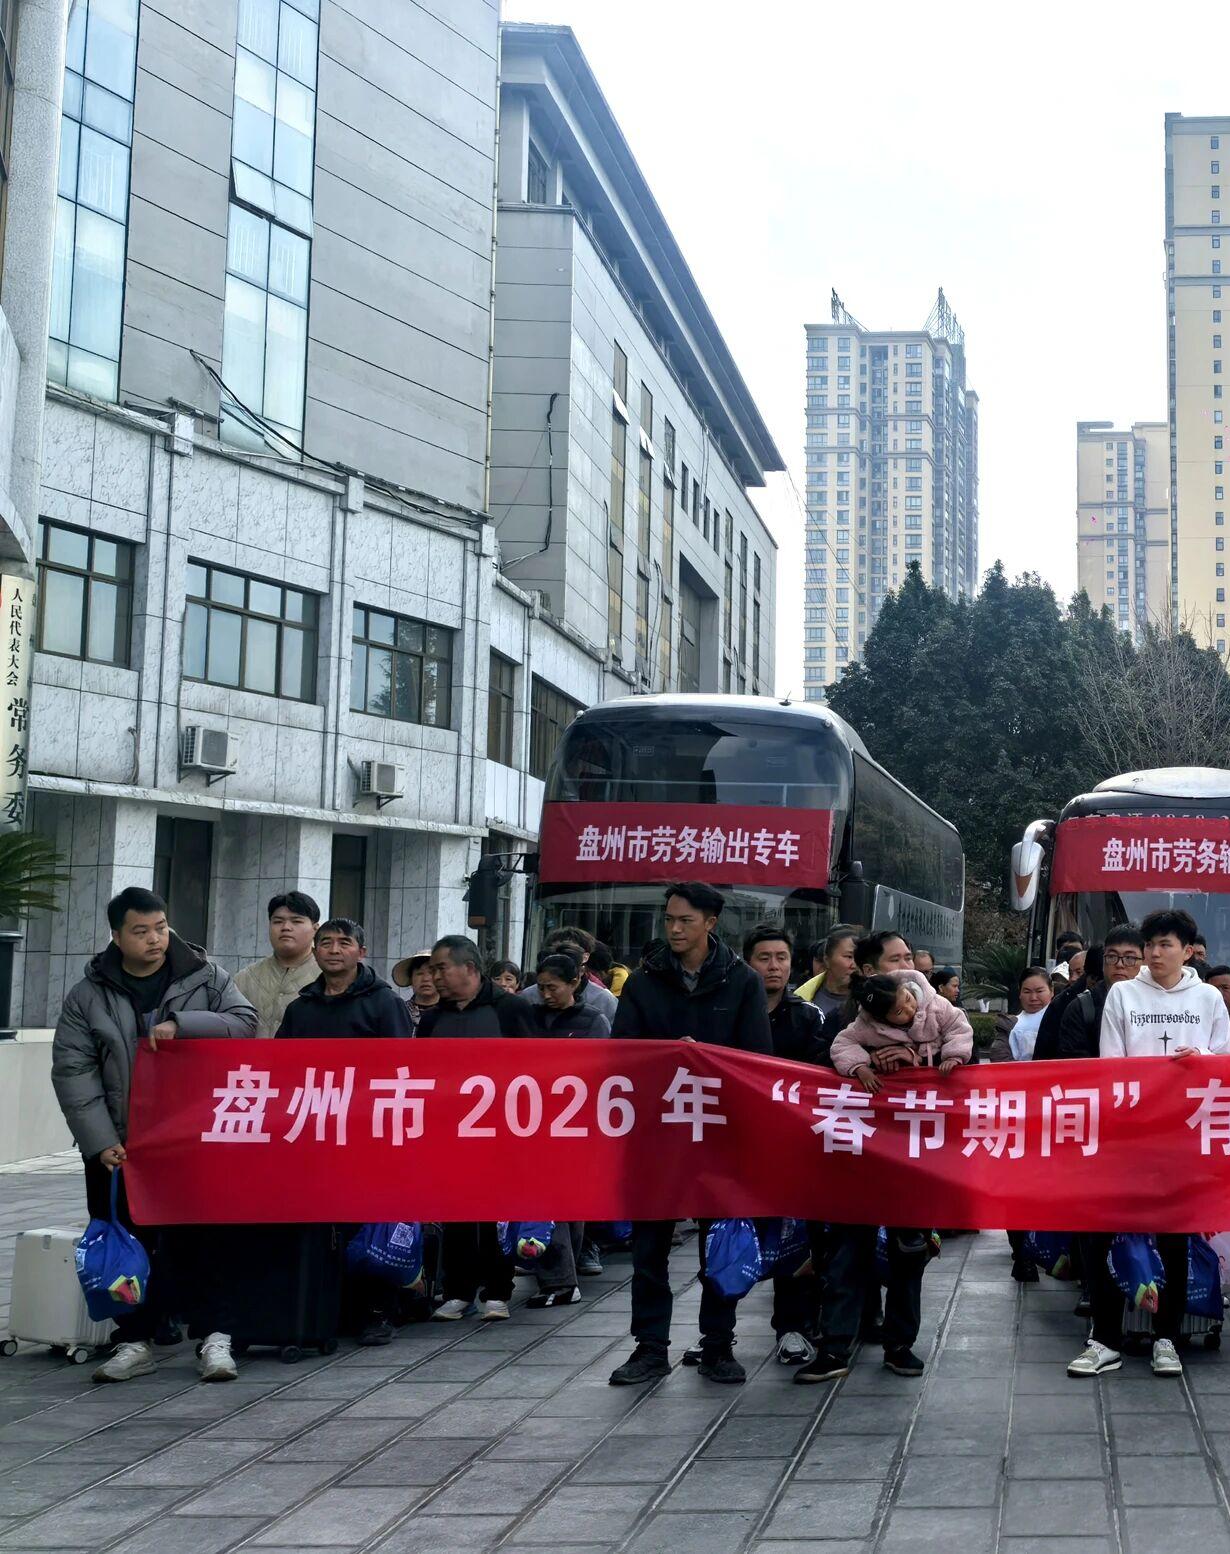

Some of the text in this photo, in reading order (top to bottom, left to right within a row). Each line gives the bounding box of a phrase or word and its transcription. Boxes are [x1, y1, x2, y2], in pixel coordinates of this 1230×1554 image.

[6, 587, 23, 686] 人民代表大会
[575, 825, 801, 867] 盘州市劳务输出专车
